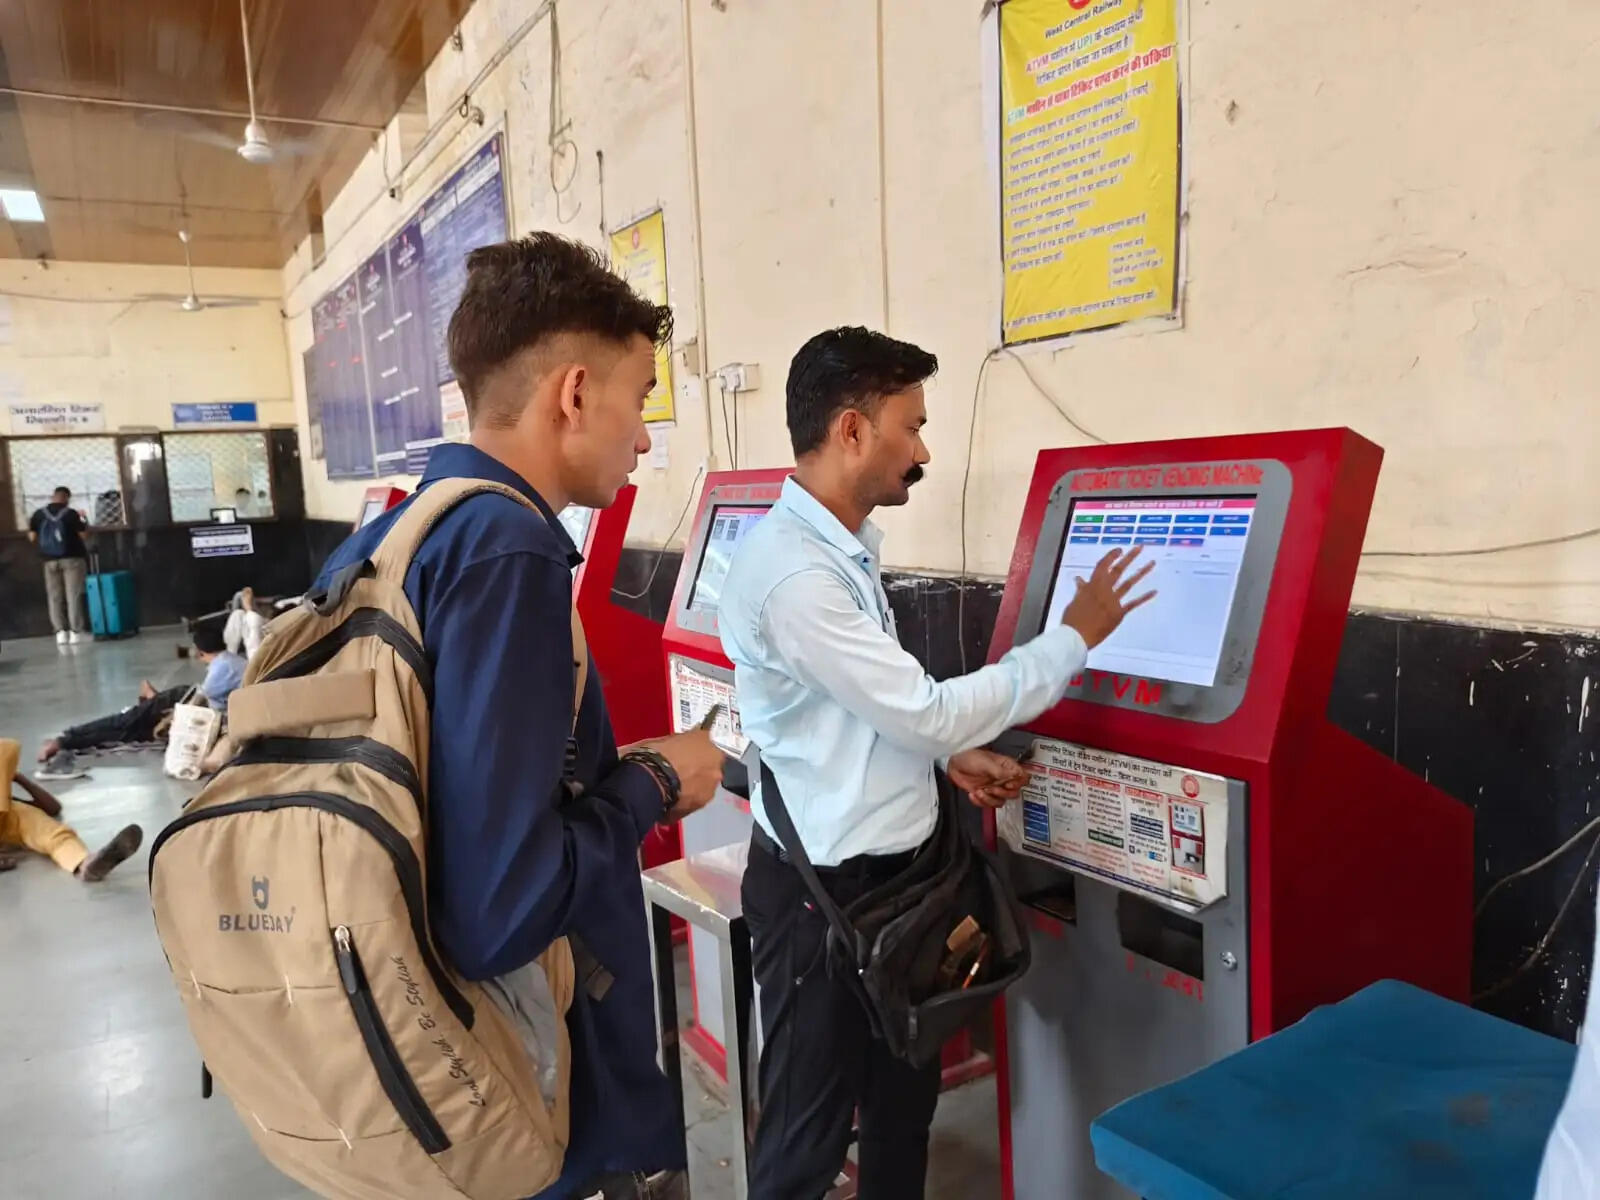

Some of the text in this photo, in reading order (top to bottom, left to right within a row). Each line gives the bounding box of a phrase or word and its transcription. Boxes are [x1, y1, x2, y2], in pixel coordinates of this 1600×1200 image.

[1064, 10, 1091, 29] Central
[1092, 0, 1122, 17] Railway
[1077, 34, 1093, 49] UPI
[1127, 469, 1160, 489] TICKET
[1162, 466, 1210, 488] VENDING
[1213, 464, 1264, 486] MACHINE
[219, 913, 294, 933] BLUEJAY
[391, 956, 425, 1008] Stylish
[417, 1010, 437, 1031] Be
